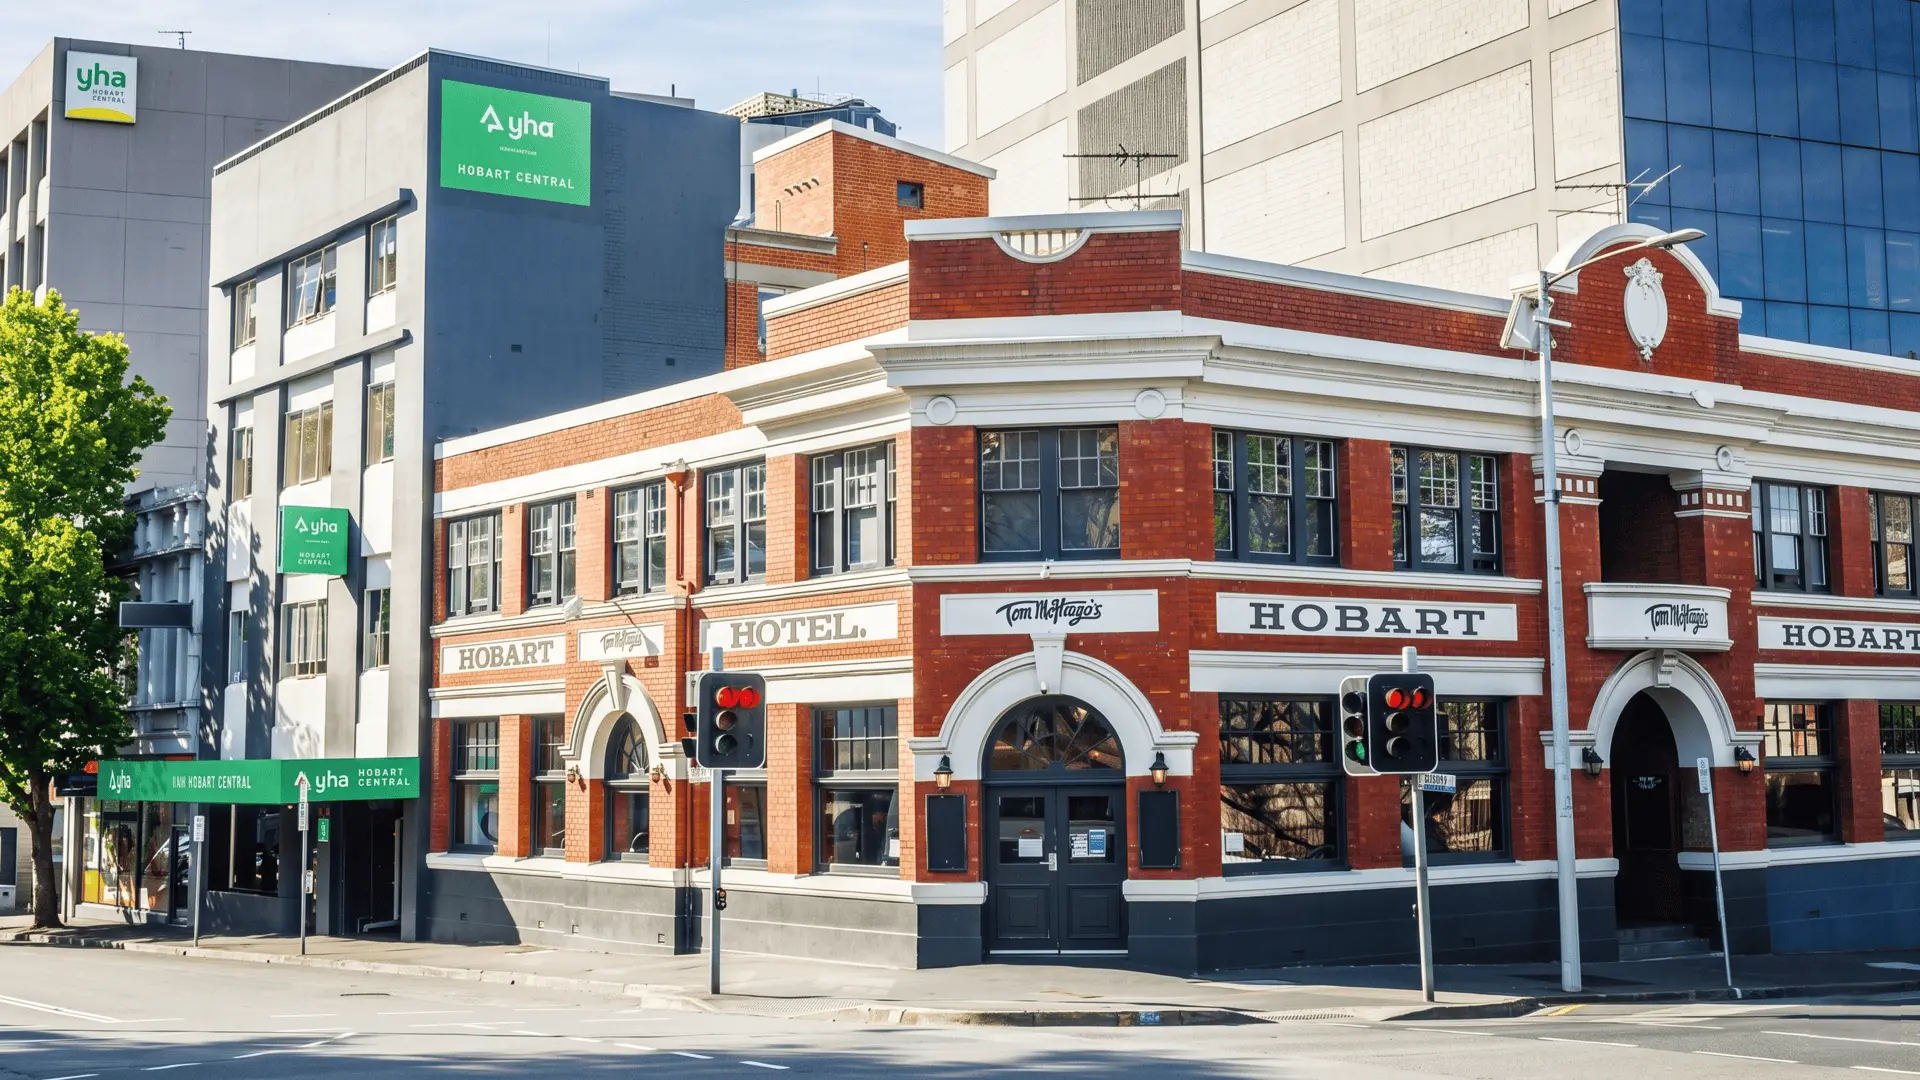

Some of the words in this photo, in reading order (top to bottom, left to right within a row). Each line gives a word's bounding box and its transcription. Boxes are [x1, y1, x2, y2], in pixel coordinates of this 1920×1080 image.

[77, 62, 126, 91] yha
[93, 89, 124, 97] HOBART
[508, 111, 554, 140] yha
[458, 163, 511, 180] HOBART
[516, 172, 575, 190] CENTRAL
[311, 517, 338, 535] yha
[297, 558, 332, 566] CENTRAL
[995, 600, 1035, 628] Tom
[1249, 602, 1485, 636] HOBART
[1644, 603, 1670, 632] Tom
[730, 612, 867, 649] HOTEL.
[1782, 624, 1920, 651] HOBART
[458, 640, 554, 670] HOBART
[116, 769, 131, 794] yha
[188, 775, 215, 789] HOBART
[217, 775, 252, 789] CENTRAL
[315, 770, 349, 793] yha
[358, 768, 404, 777] HOBART
[358, 777, 411, 787] CENTRAL
